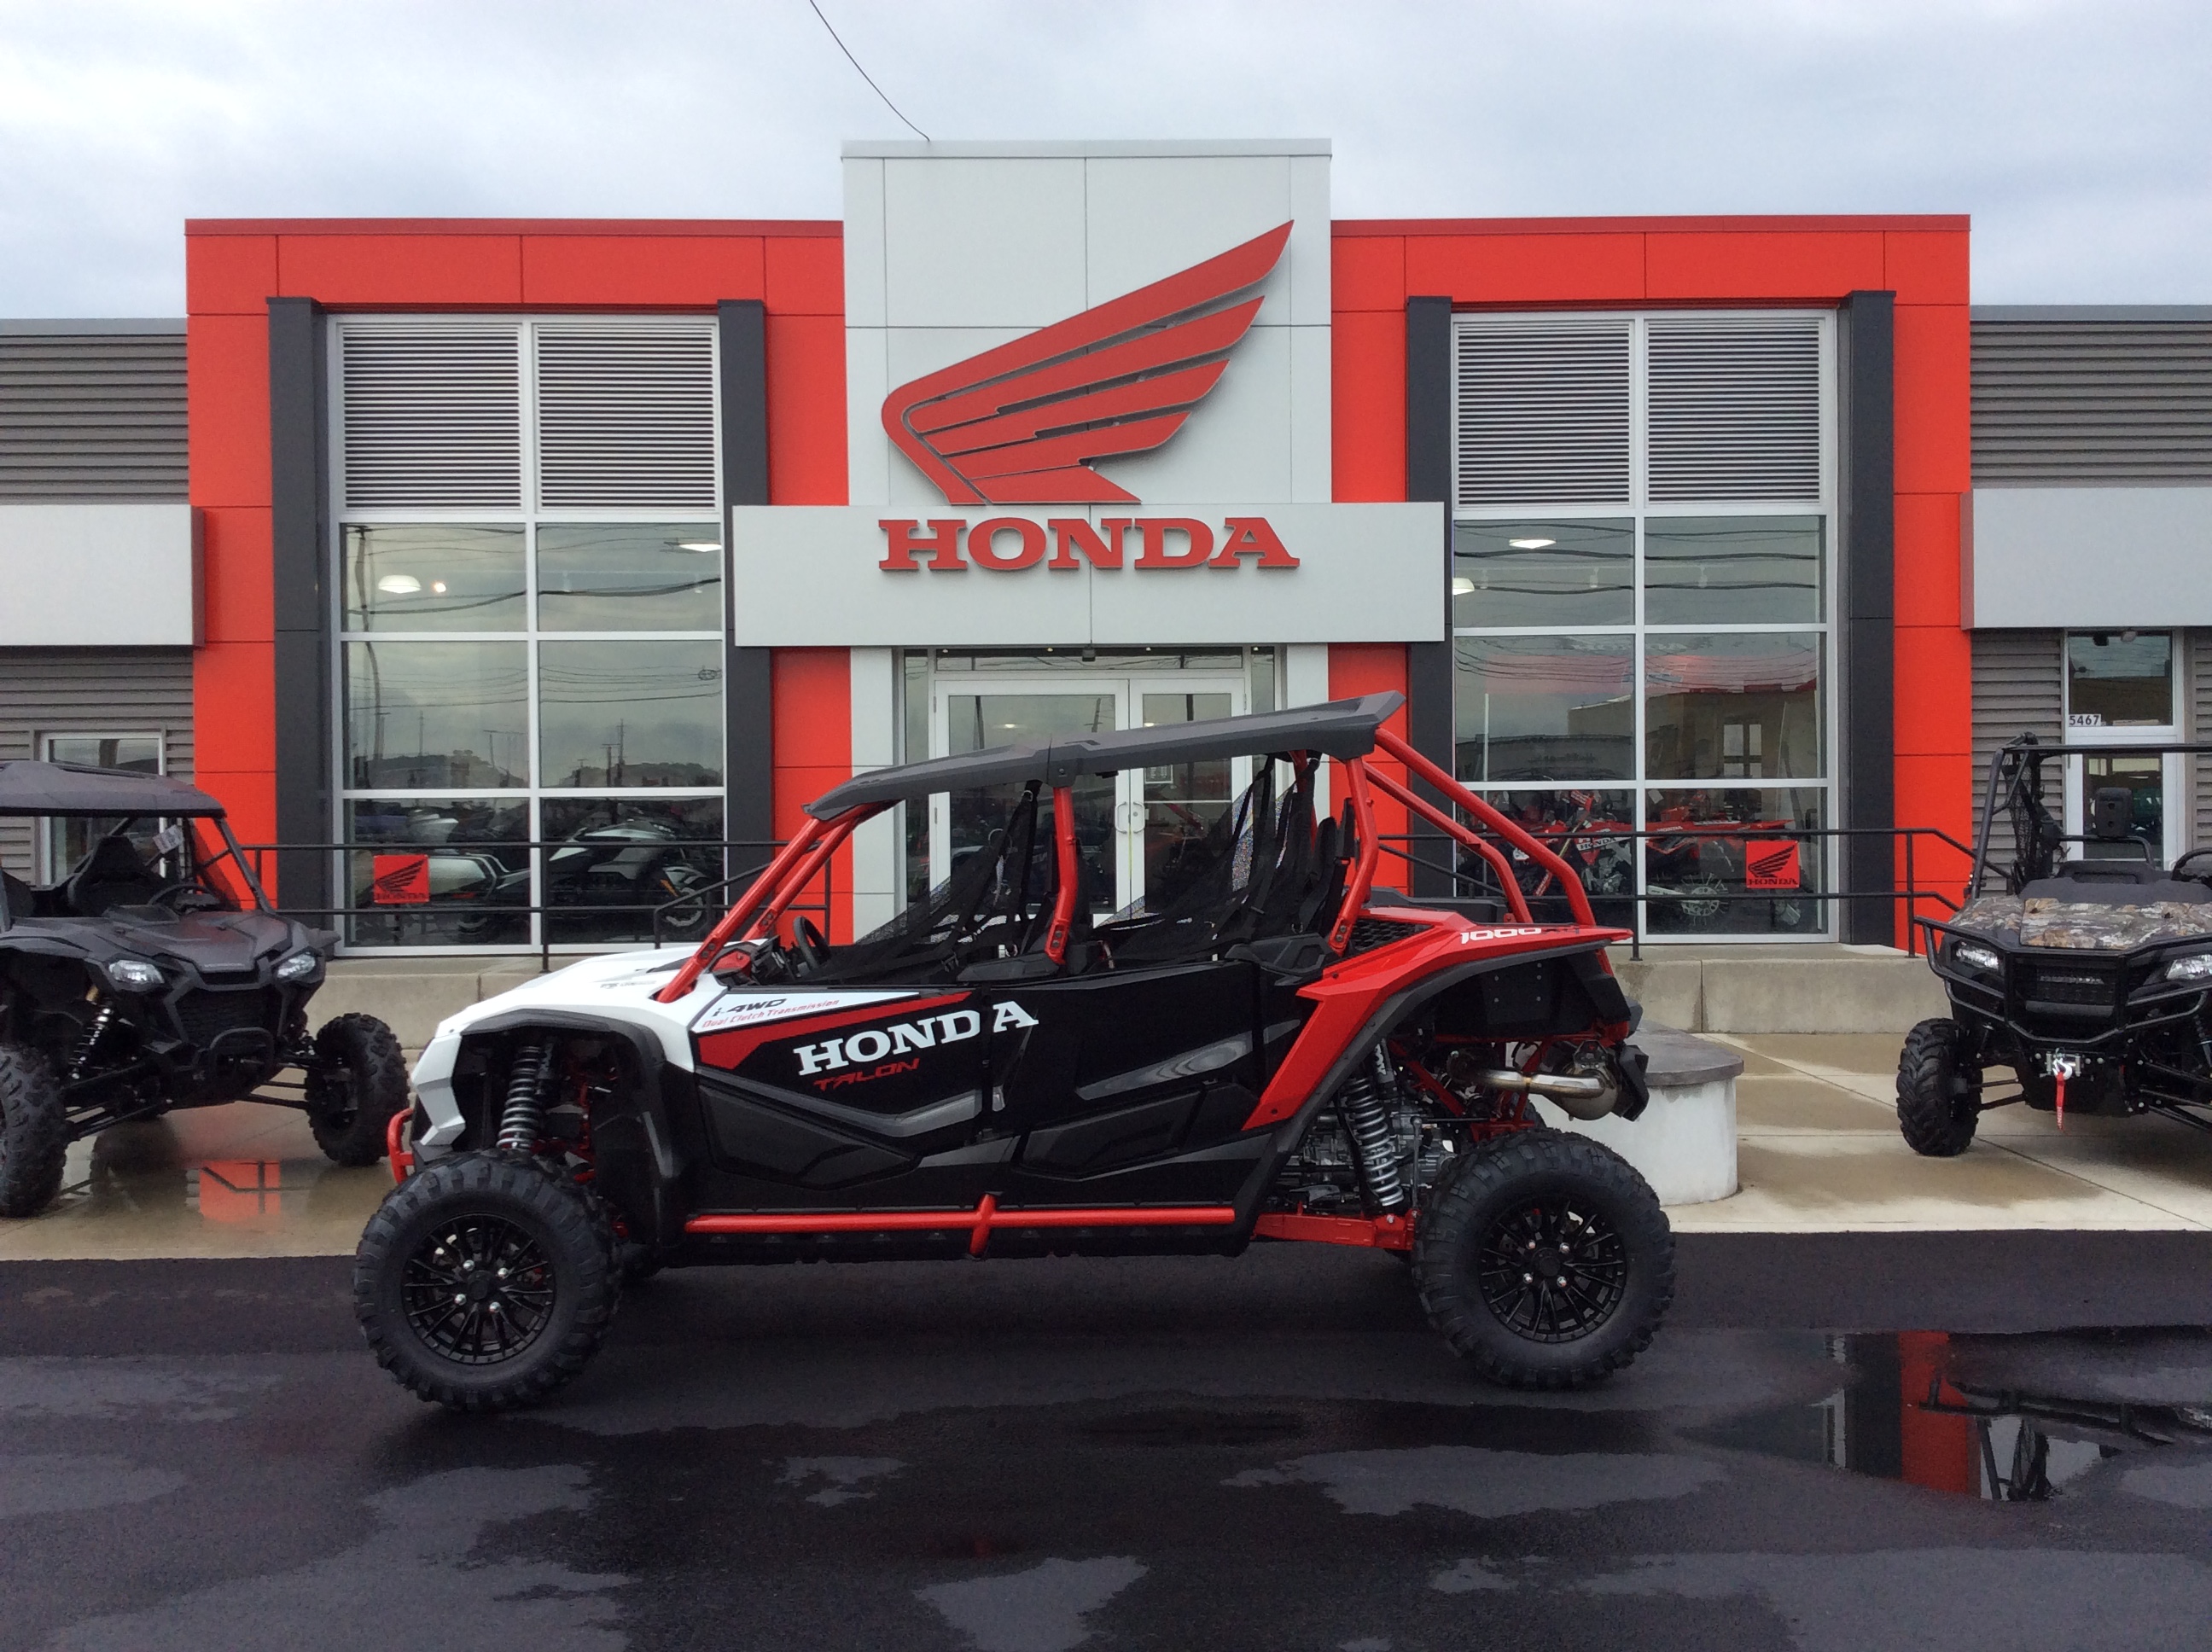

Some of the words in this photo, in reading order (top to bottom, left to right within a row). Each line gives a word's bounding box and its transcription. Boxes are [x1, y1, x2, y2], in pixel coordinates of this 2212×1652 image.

[878, 517, 1300, 570] HONDA
[2069, 714, 2100, 725] 5467
[1460, 928, 1541, 945] 1000
[701, 1018, 727, 1028] Dual
[730, 1011, 765, 1023] Clutch
[766, 999, 840, 1017] Transmission
[712, 998, 787, 1017] i-4WD
[793, 1000, 1039, 1076] HONDA
[813, 1058, 920, 1091] TALON
